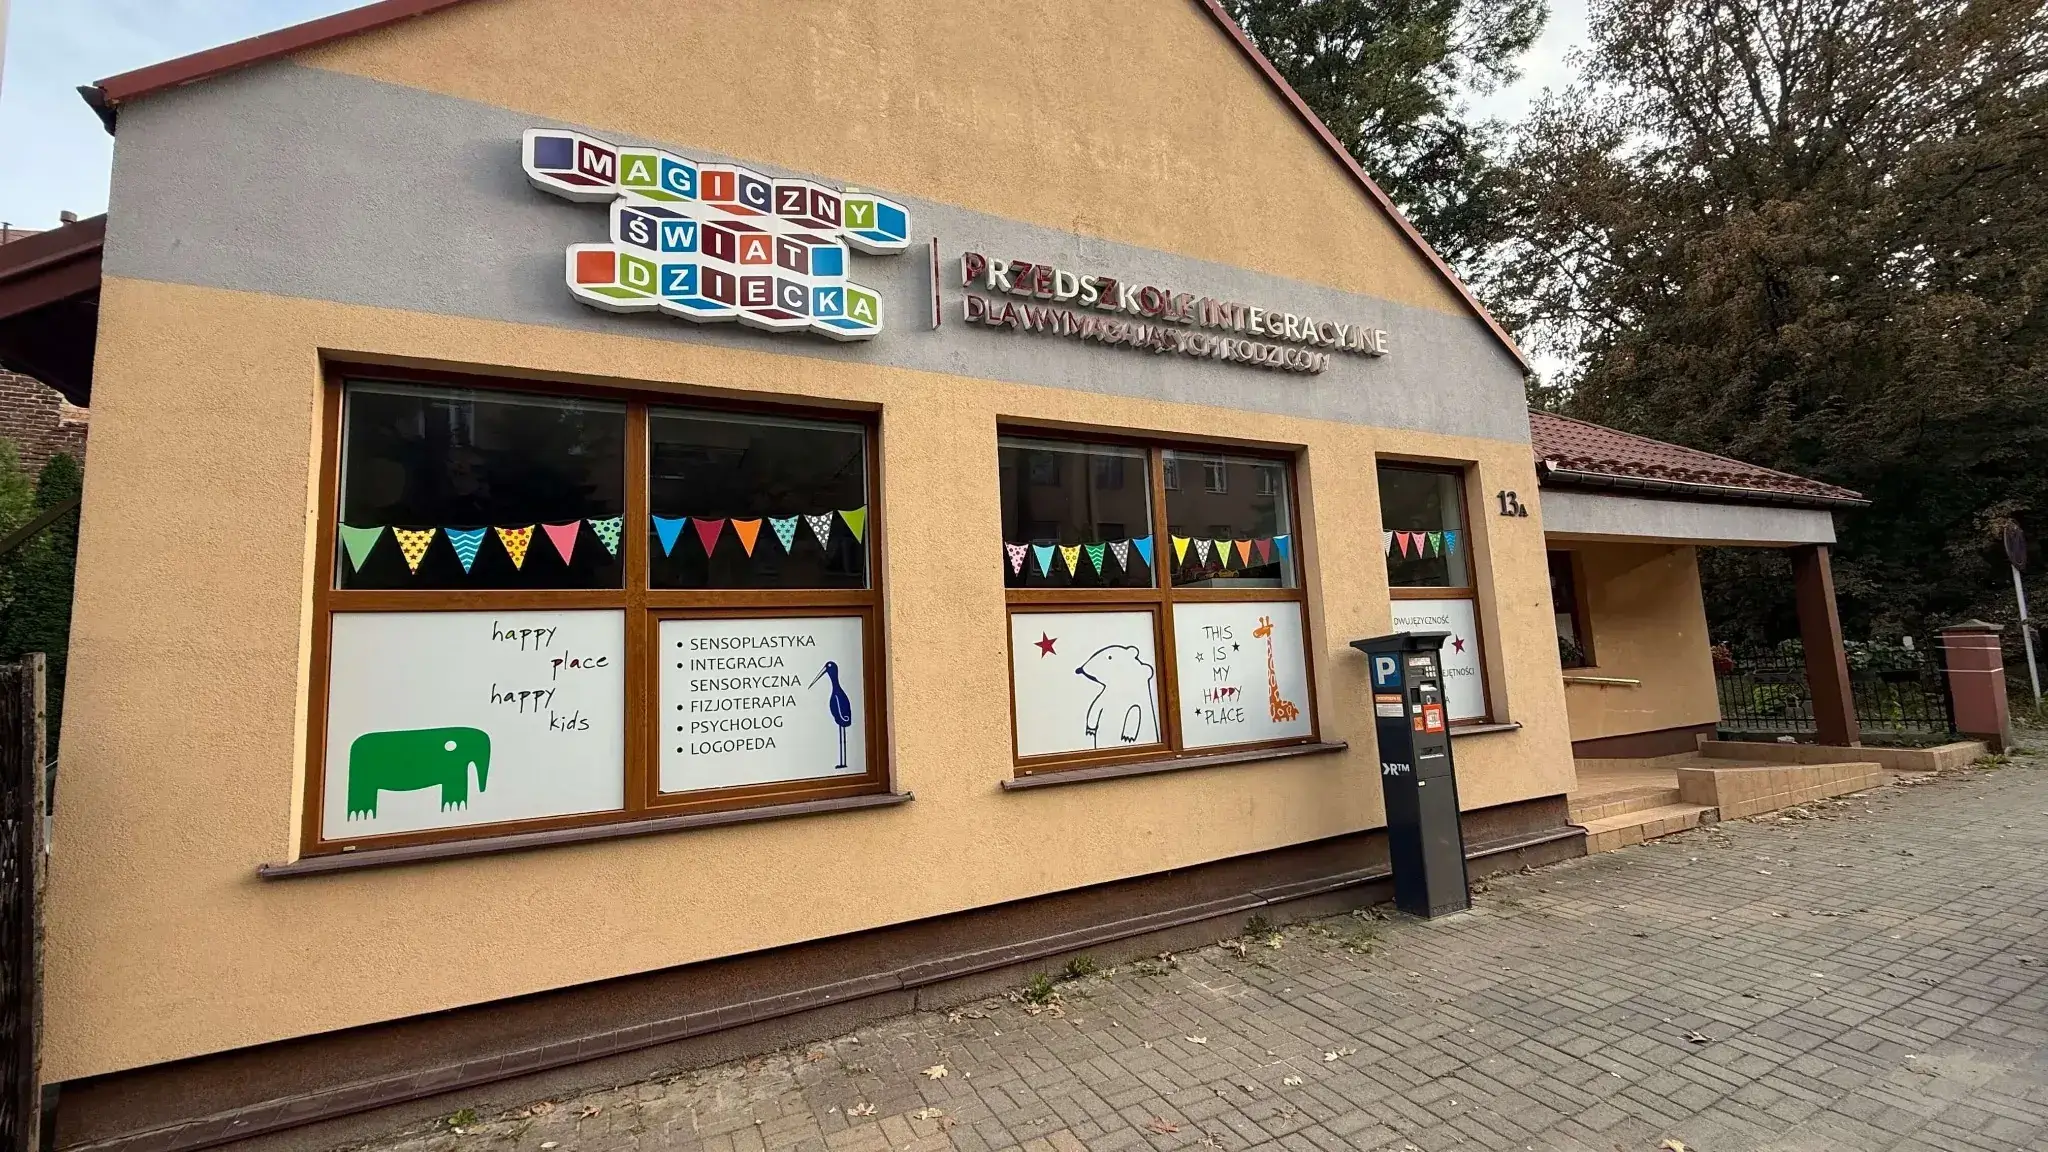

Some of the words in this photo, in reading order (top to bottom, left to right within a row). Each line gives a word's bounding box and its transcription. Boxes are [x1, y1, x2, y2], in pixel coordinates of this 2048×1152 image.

[583, 149, 867, 224] MAGICZNY
[630, 216, 802, 267] ŚWIAT
[629, 264, 874, 320] DZIECKA
[961, 252, 1195, 323] PRZEDSZKOLE
[1198, 297, 1389, 356] INTEGRACYJNE
[964, 295, 1018, 328] DLA
[1497, 490, 1529, 517] 13A
[492, 621, 557, 651] happy
[1202, 625, 1233, 641] THIS
[690, 635, 816, 650] SENSOPLASTYKA
[1213, 646, 1227, 662] IS
[551, 651, 609, 680] place
[691, 656, 784, 671] INTEGRACJA
[1375, 657, 1396, 685] P
[1442, 665, 1475, 679] EJĘTNOŚCI
[1213, 665, 1230, 681] MY
[690, 675, 801, 692] SENSORYCZNA
[490, 684, 556, 713] happy
[691, 695, 796, 713] FIZJOTERAPIA
[1203, 686, 1242, 704] HAPPY
[549, 710, 590, 731] kids
[1204, 707, 1245, 724] PLACE
[691, 716, 783, 734] PSYCHOLOG
[691, 737, 776, 755] LOGOPEDA
